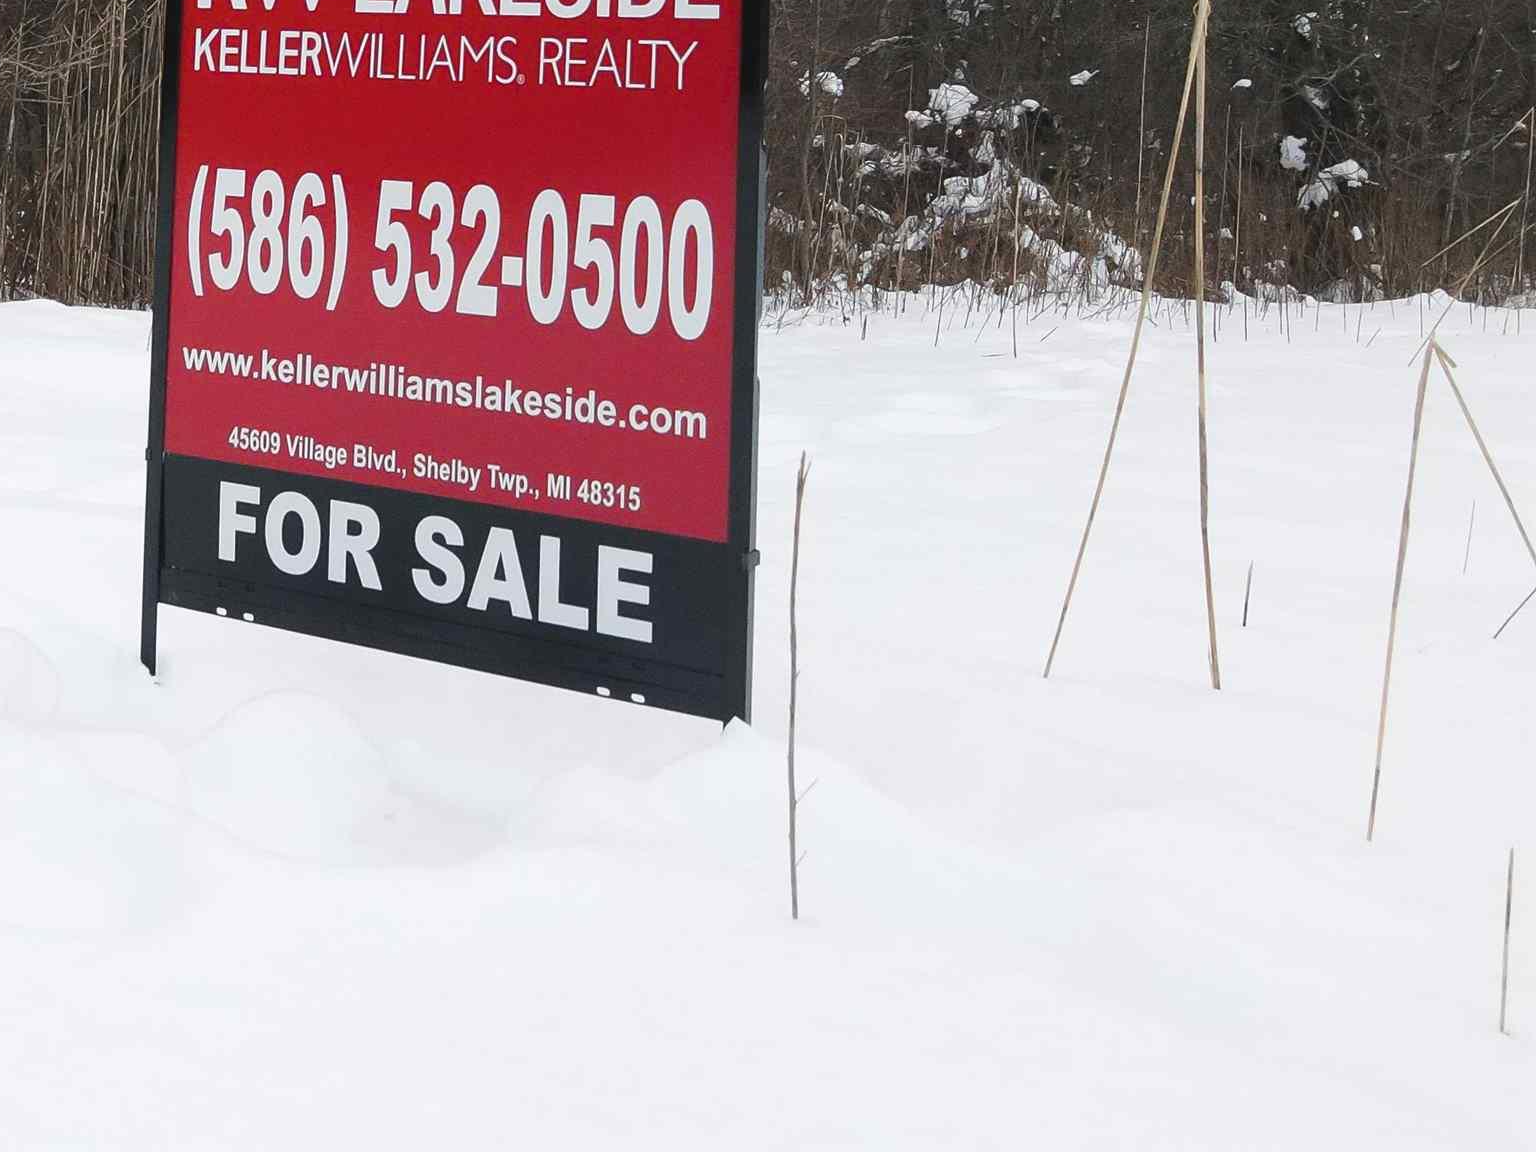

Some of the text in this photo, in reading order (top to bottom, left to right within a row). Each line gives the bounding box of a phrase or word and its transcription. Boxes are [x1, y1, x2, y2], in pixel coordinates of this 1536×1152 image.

[538, 38, 698, 90] REALTY
[188, 165, 714, 341] (586) 532-0500
[182, 346, 708, 439] www.kellerwilliamslakeside.com
[228, 426, 641, 512] 45609 Village Blvd., Shelby Twp., MI 48315
[218, 480, 654, 644] FOR SALE
